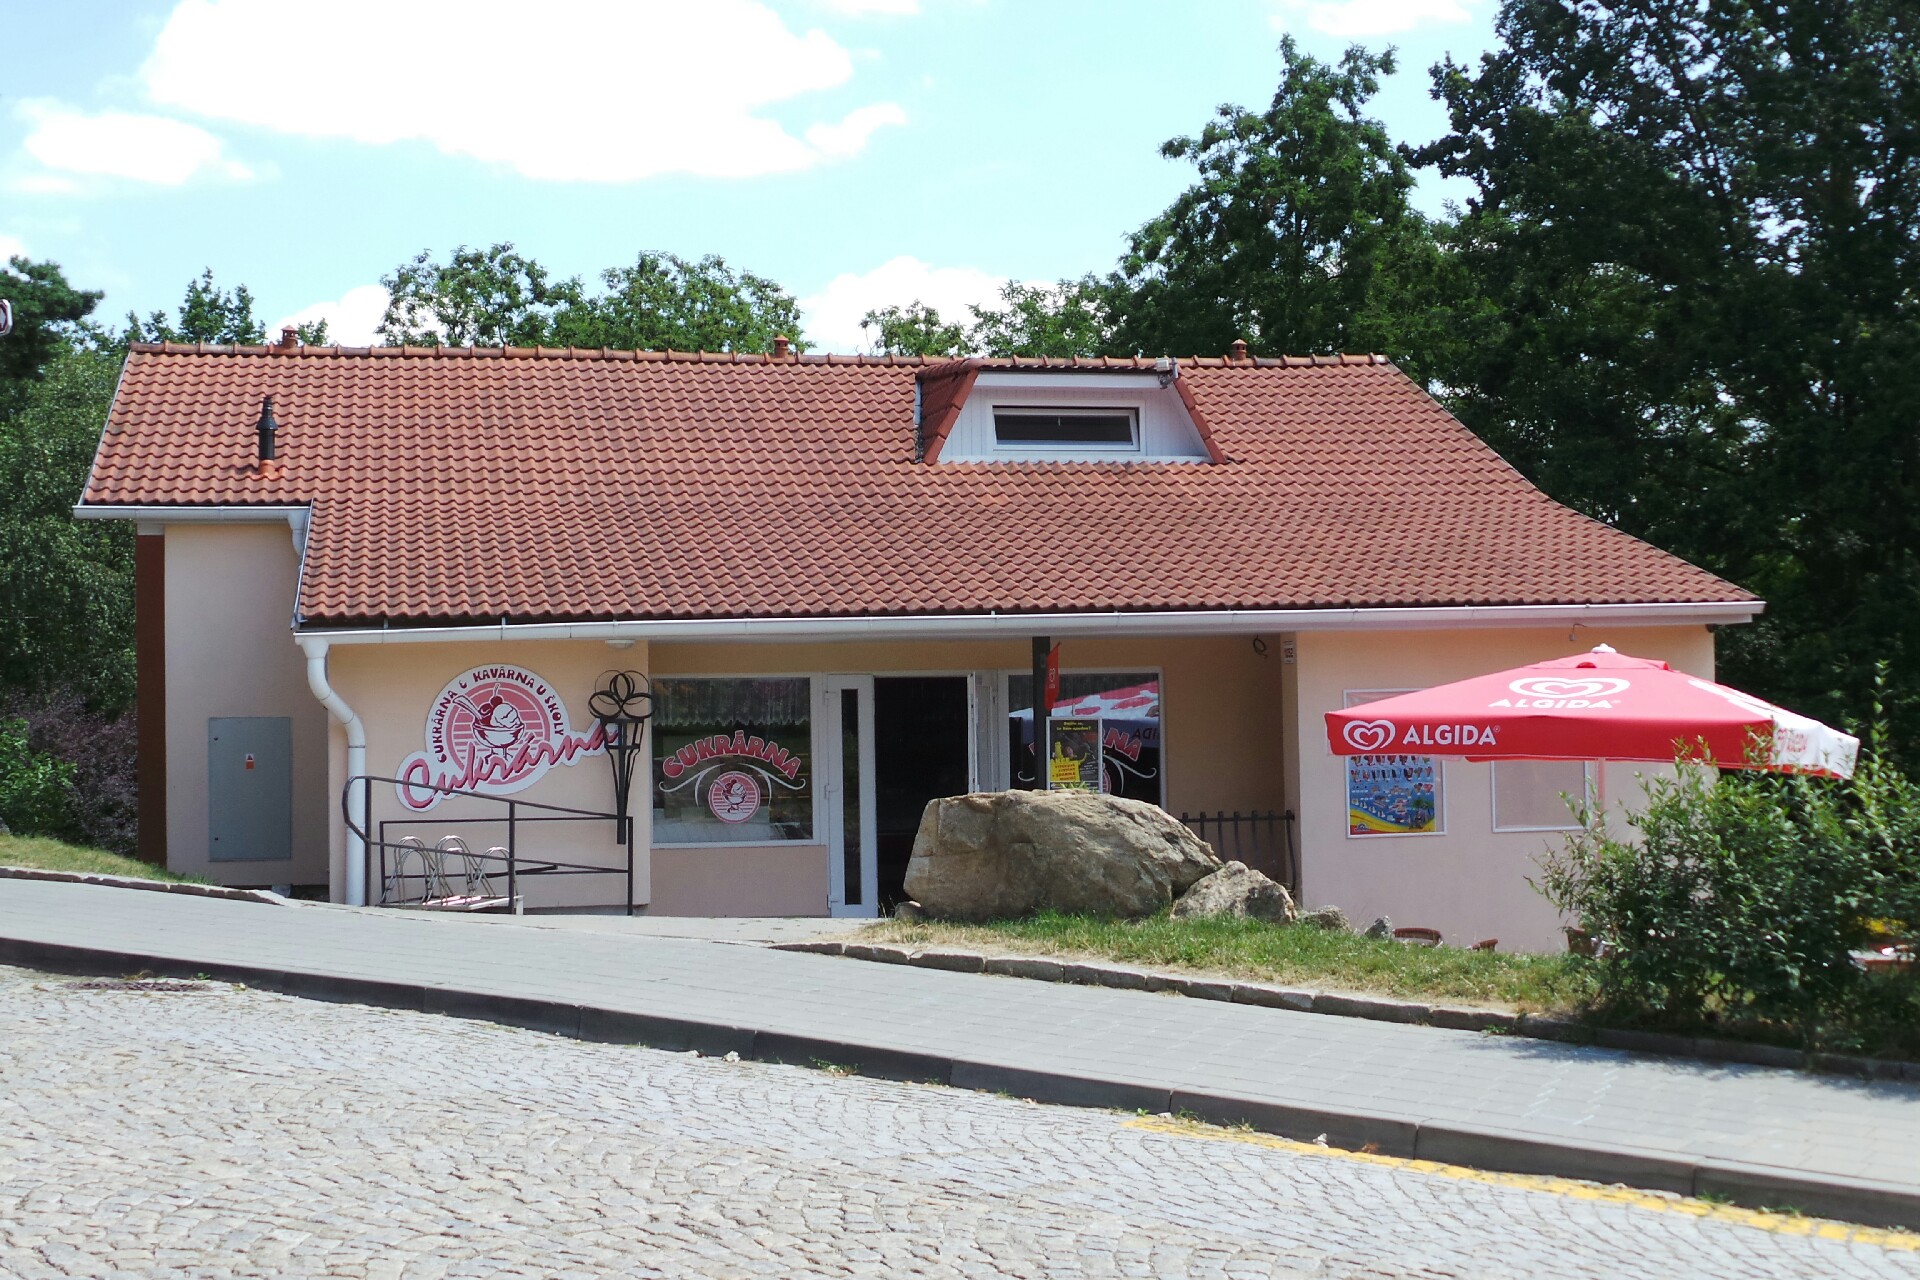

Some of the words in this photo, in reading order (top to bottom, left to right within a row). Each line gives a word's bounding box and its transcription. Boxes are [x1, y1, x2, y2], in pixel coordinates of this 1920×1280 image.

[473, 667, 534, 689] KAVÁRNA
[536, 685, 546, 696] U
[544, 695, 564, 736] ŠKOLY
[1488, 698, 1612, 709] ALGIDA
[662, 729, 802, 780] CUKRÁRNA
[1402, 724, 1497, 746] ALGIDA
[402, 722, 619, 809] Cukrárna
